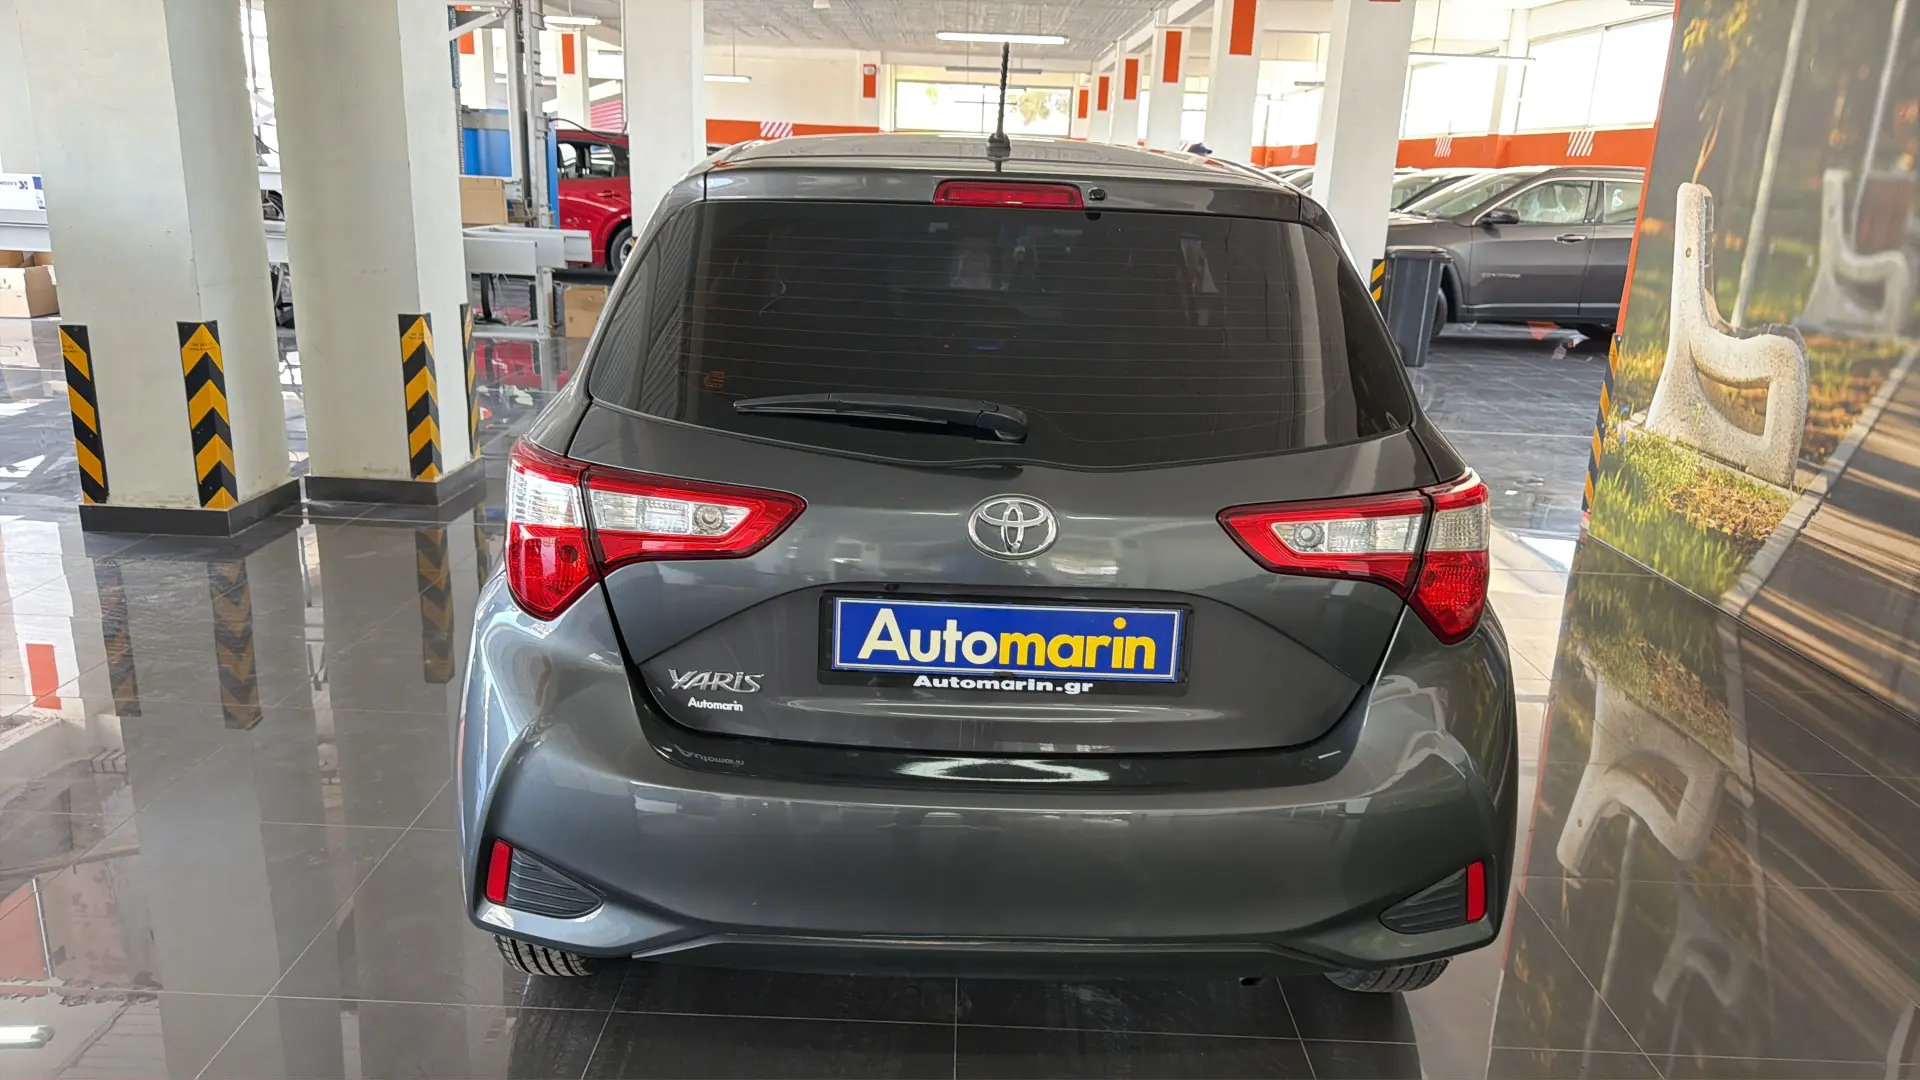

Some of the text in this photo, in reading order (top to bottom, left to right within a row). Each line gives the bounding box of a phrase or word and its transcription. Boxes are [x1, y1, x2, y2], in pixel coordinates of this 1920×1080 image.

[857, 607, 1156, 670] Automarin
[668, 668, 764, 693] YARIS
[913, 675, 1093, 694] Automarin.gr
[687, 696, 744, 712] Automarin
